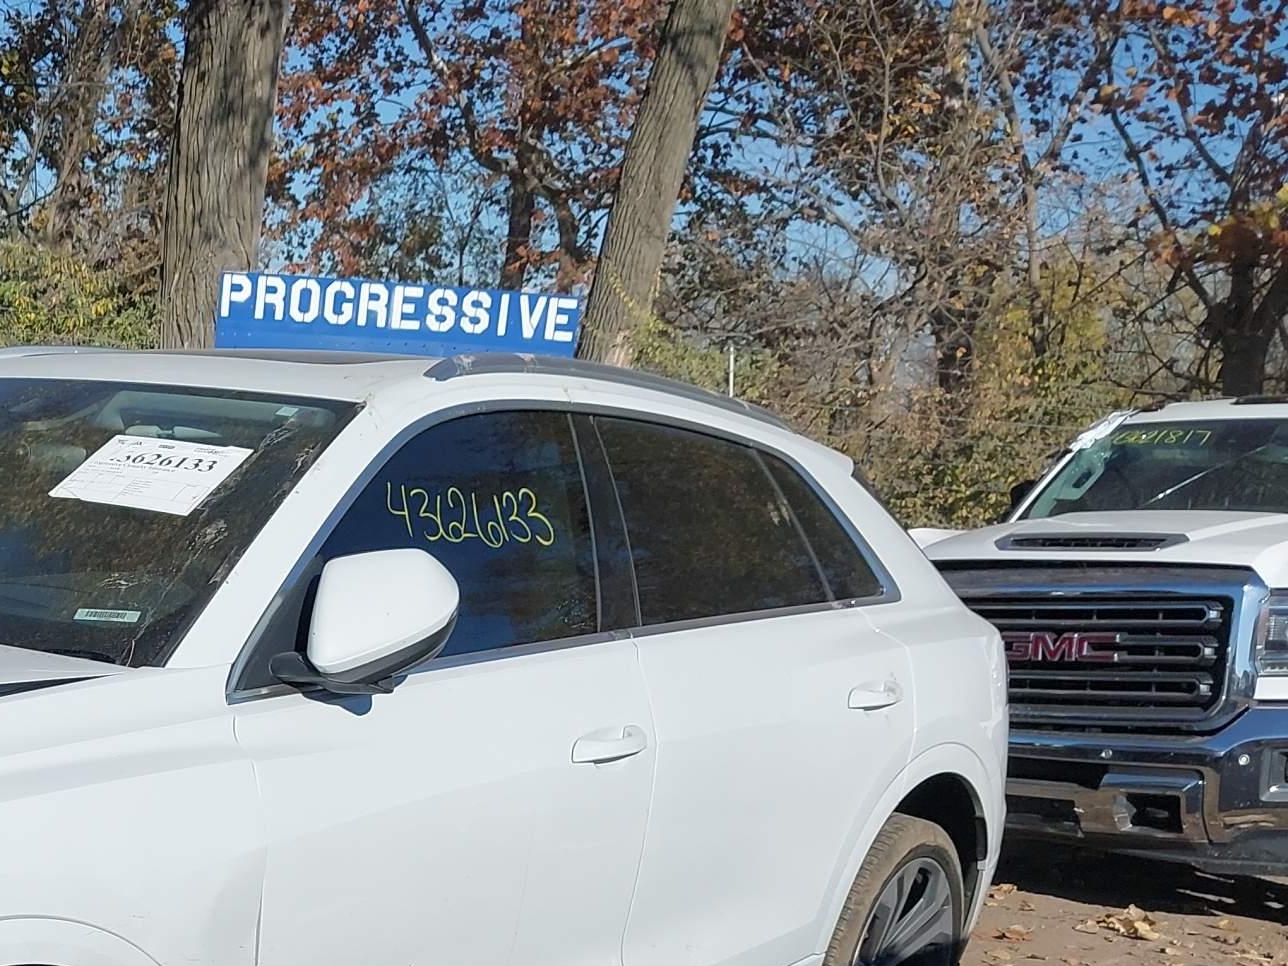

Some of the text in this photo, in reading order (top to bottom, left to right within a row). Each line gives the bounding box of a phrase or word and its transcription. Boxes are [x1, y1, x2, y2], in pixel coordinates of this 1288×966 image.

[220, 272, 579, 343] PROGRESSIVE
[386, 481, 555, 548] 43626133
[1001, 631, 1120, 663] GMC
